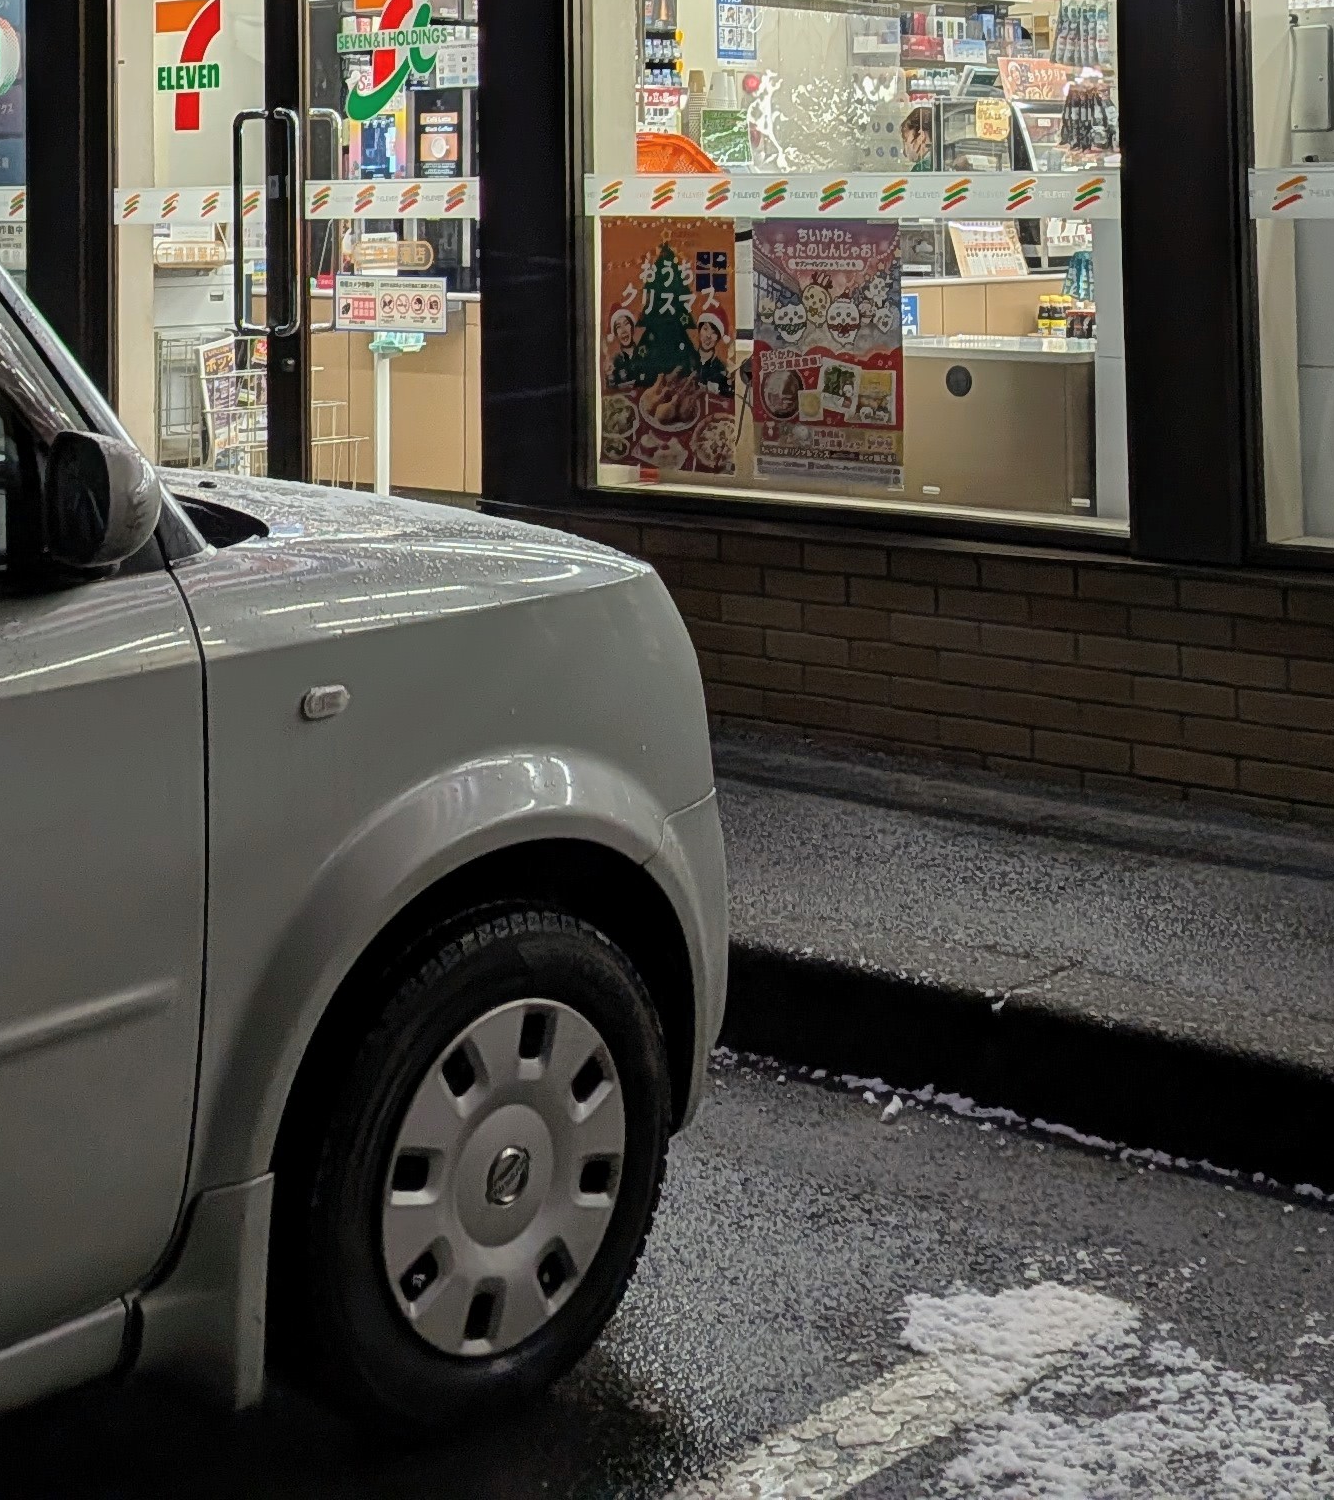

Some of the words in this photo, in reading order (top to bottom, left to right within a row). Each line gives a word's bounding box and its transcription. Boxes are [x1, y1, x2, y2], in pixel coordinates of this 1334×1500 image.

[388, 27, 448, 47] HOLDINGS
[797, 228, 852, 242] ちいかわと
[773, 243, 877, 257] 冬をたのしんじゃお!
[639, 257, 694, 287] おうち
[621, 283, 720, 315] クリスマス
